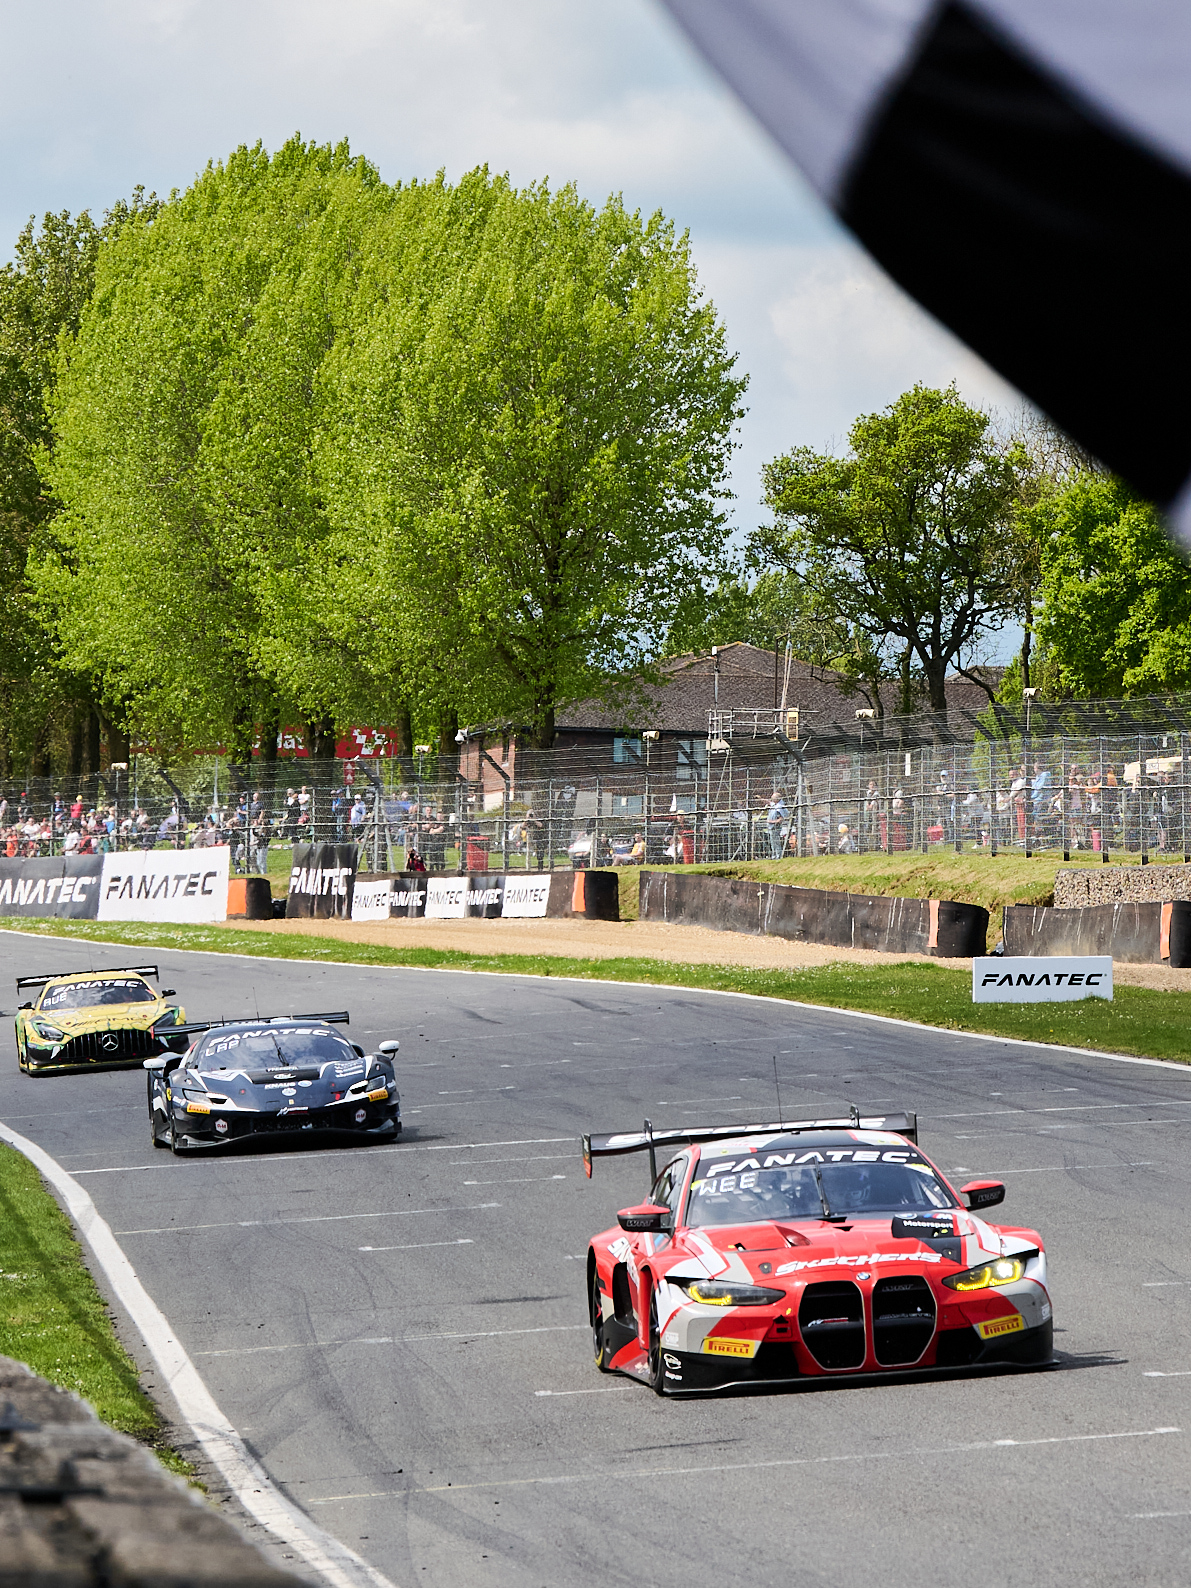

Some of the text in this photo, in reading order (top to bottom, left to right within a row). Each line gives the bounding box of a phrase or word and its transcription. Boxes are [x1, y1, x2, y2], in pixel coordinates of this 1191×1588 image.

[107, 871, 217, 899] FANATEC
[289, 867, 349, 895] FANATEC
[0, 877, 91, 905] ANATEC
[353, 892, 387, 908] FANATEC
[428, 890, 462, 904] FANATEC
[505, 888, 546, 904] FANATEC
[53, 980, 139, 996] FANATEC
[981, 973, 1103, 986] FANATEC
[209, 1028, 330, 1047] FANATEC
[706, 1151, 910, 1177] FANATEC
[700, 1172, 755, 1196] WEE
[903, 1220, 953, 1228] Motorsport
[775, 1252, 942, 1276] SKECHERS
[983, 1318, 1019, 1336] PIRELLI
[708, 1341, 750, 1354] PIRELLI
